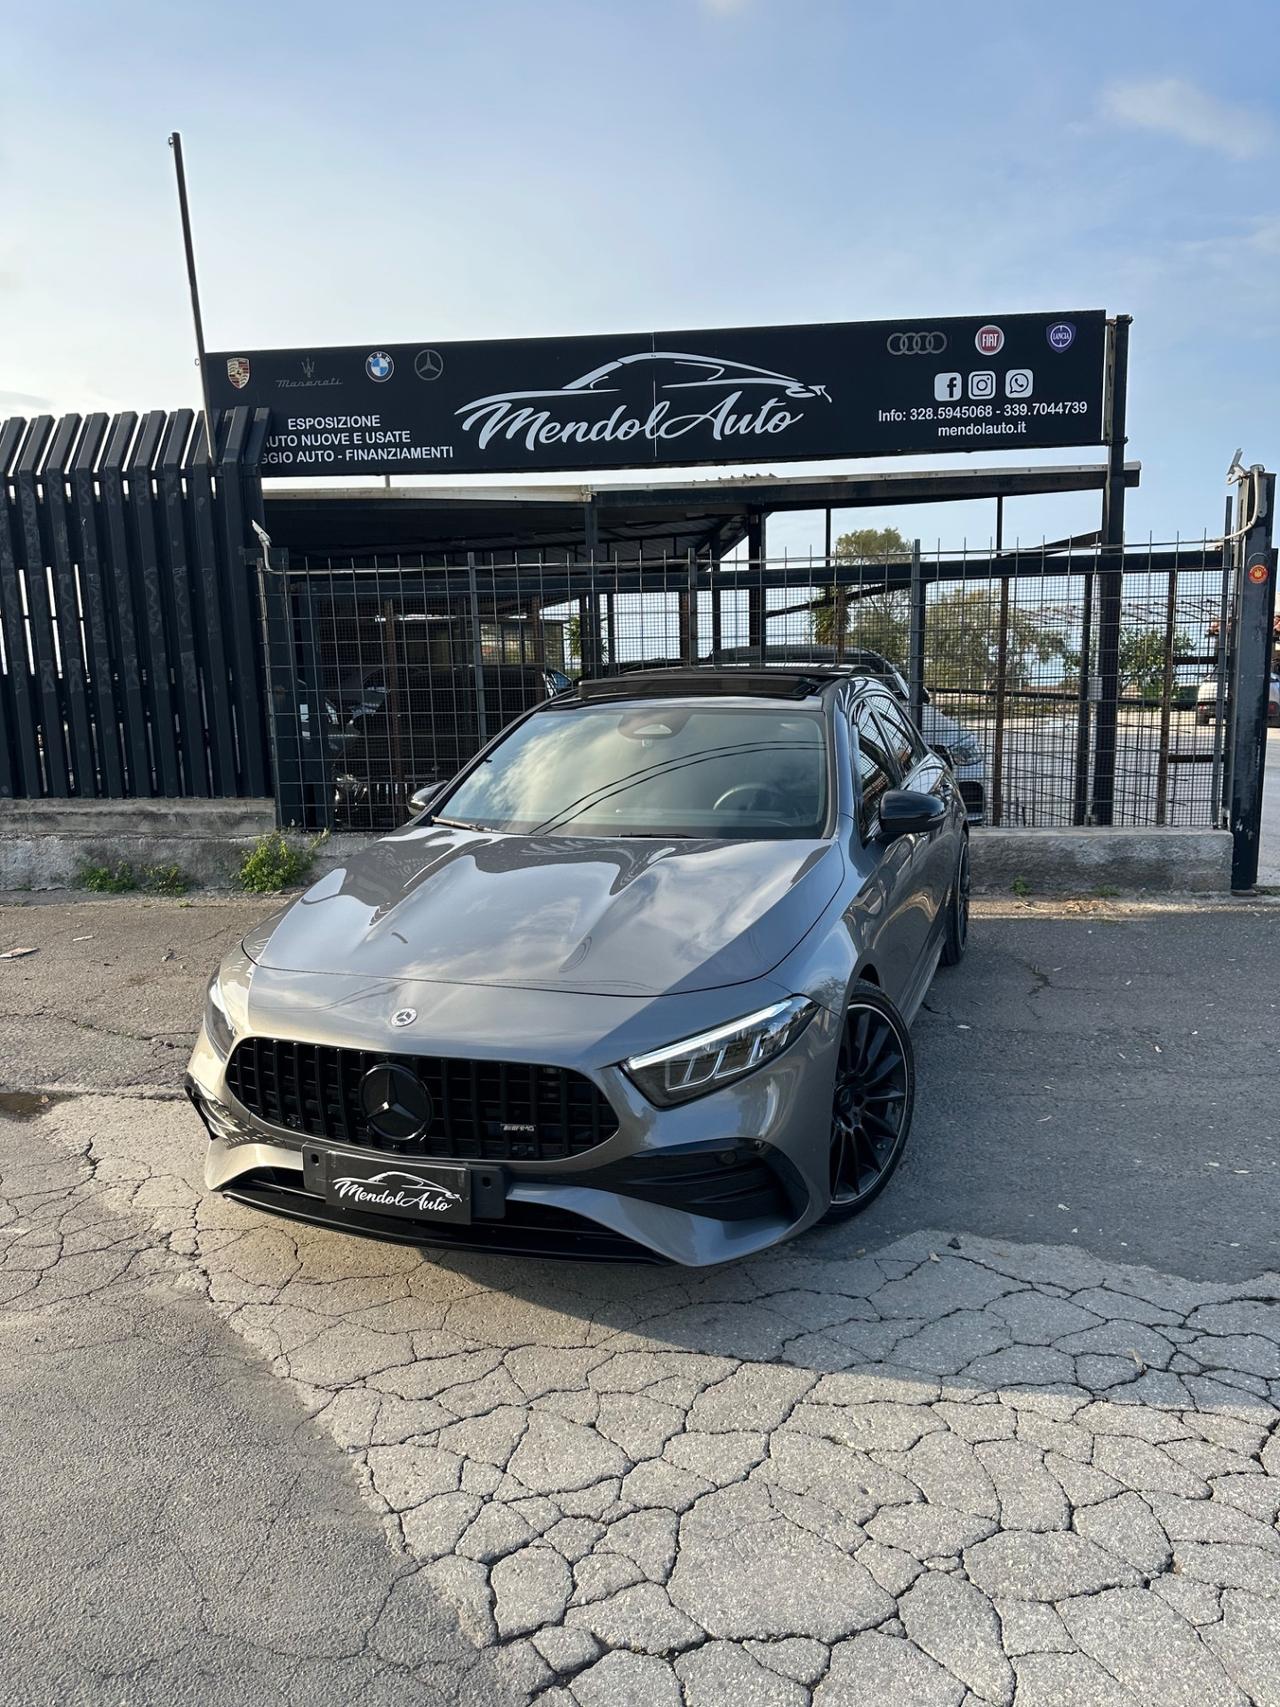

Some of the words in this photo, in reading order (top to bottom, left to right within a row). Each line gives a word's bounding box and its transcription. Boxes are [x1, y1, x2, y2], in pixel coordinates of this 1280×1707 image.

[981, 333, 998, 348] FIAT
[878, 407, 906, 422] Info:
[910, 405, 993, 420] 328.5945068
[1004, 401, 1088, 416] 339.7044739
[288, 415, 381, 430] ESPOSIZIONE
[938, 421, 1027, 436] mendolauto.it
[266, 434, 297, 448] UTO
[301, 433, 350, 446] NUOVE
[354, 432, 362, 444] E
[366, 431, 411, 443] USATE
[261, 451, 293, 465] GGIO
[296, 449, 334, 463] AUTO
[346, 446, 453, 461] FINANZIAMENTI
